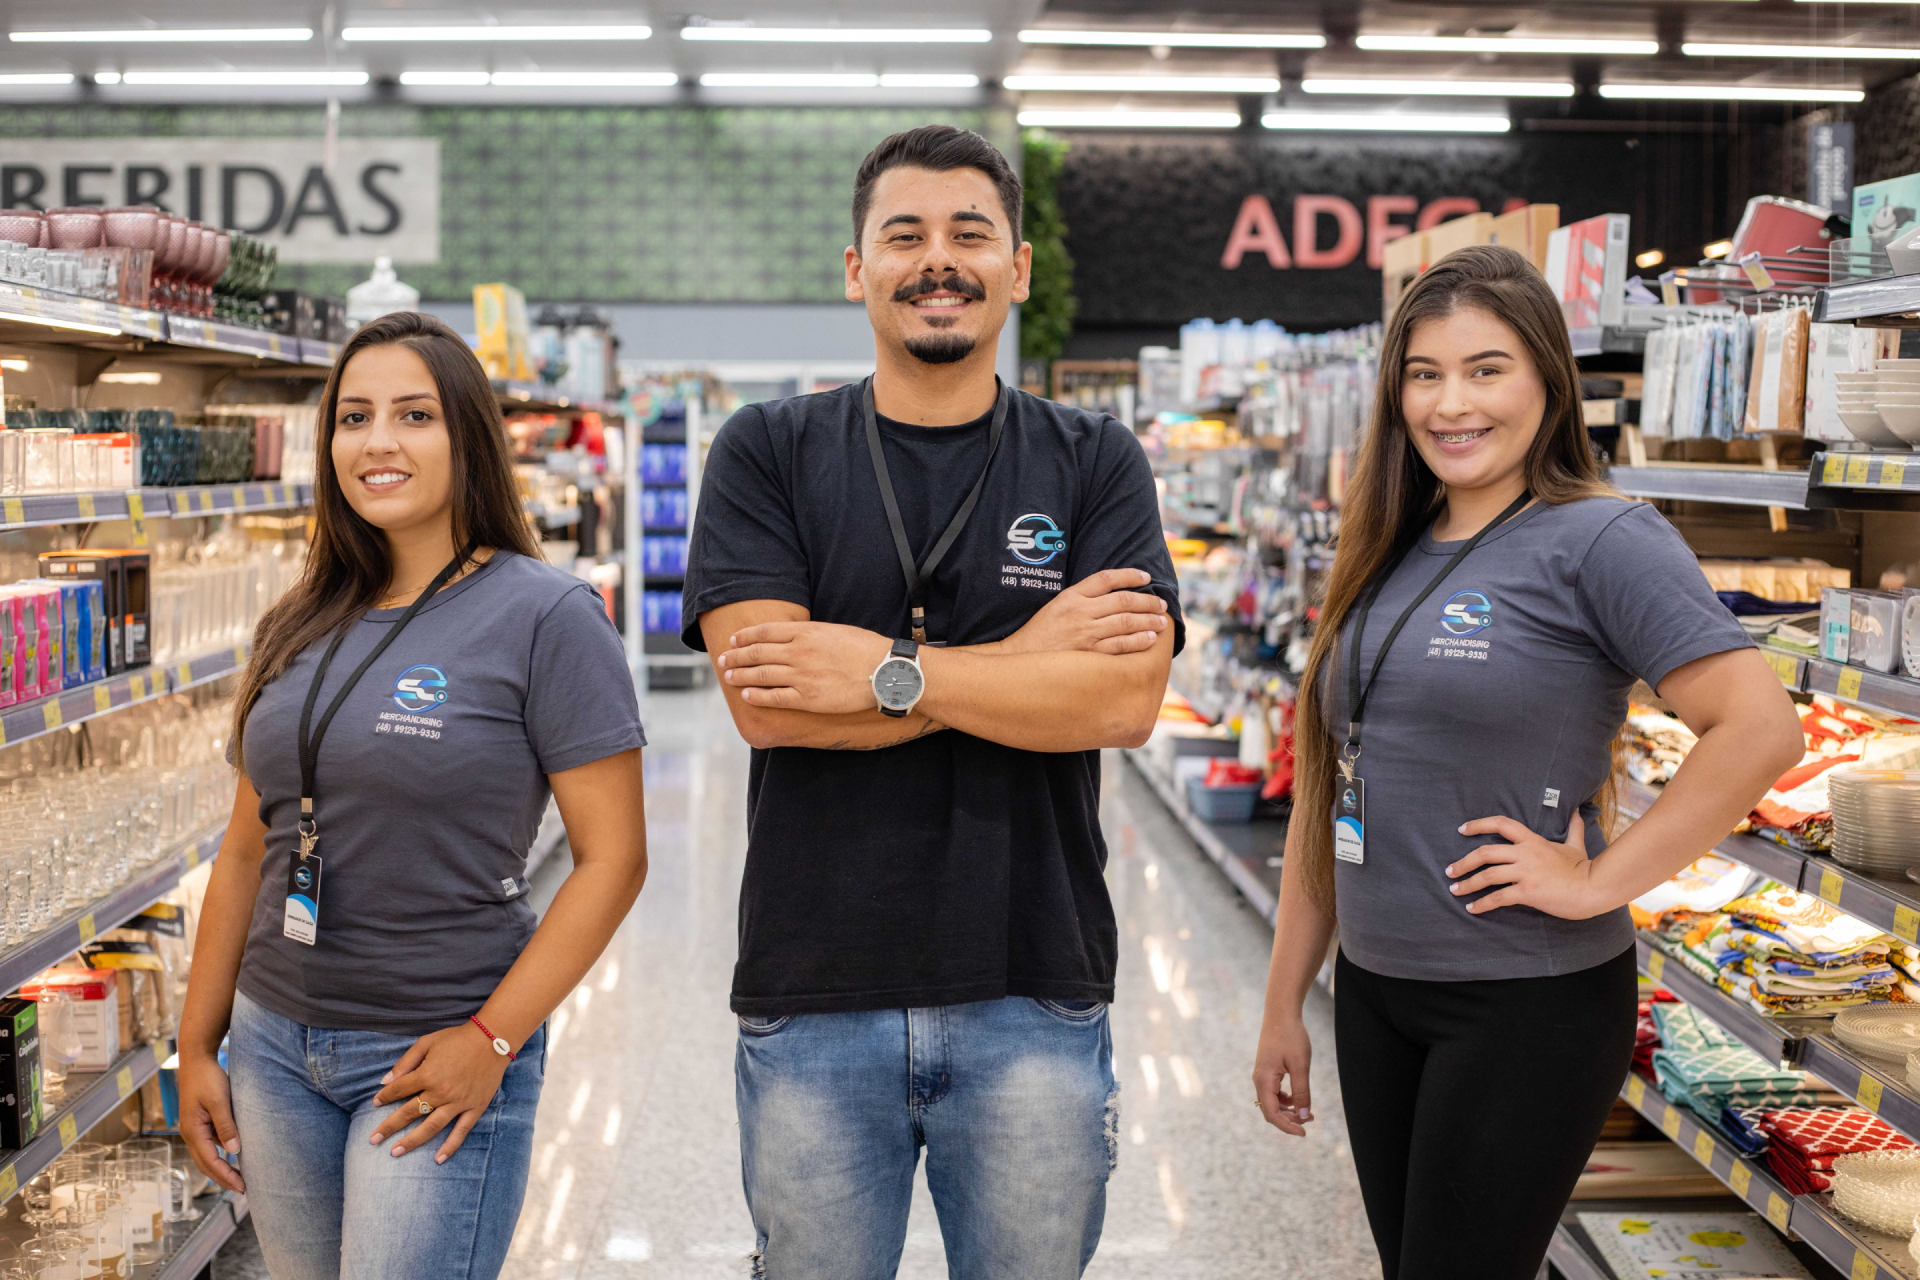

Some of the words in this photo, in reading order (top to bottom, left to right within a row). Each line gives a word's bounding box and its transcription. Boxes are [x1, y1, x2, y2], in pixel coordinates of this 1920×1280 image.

[1220, 194, 1531, 270] ADE
[1002, 565, 1062, 579] MERCHANDISING
[1001, 576, 1017, 587] (48)
[1021, 577, 1061, 591] 99129-9330
[1429, 637, 1490, 649] MERCHANDISING
[1427, 647, 1441, 658] (48)
[1444, 648, 1488, 660] 99129-9330
[379, 711, 443, 728] MERCHANDISING
[375, 722, 391, 733] (48)
[394, 724, 440, 740] 99129-9330
